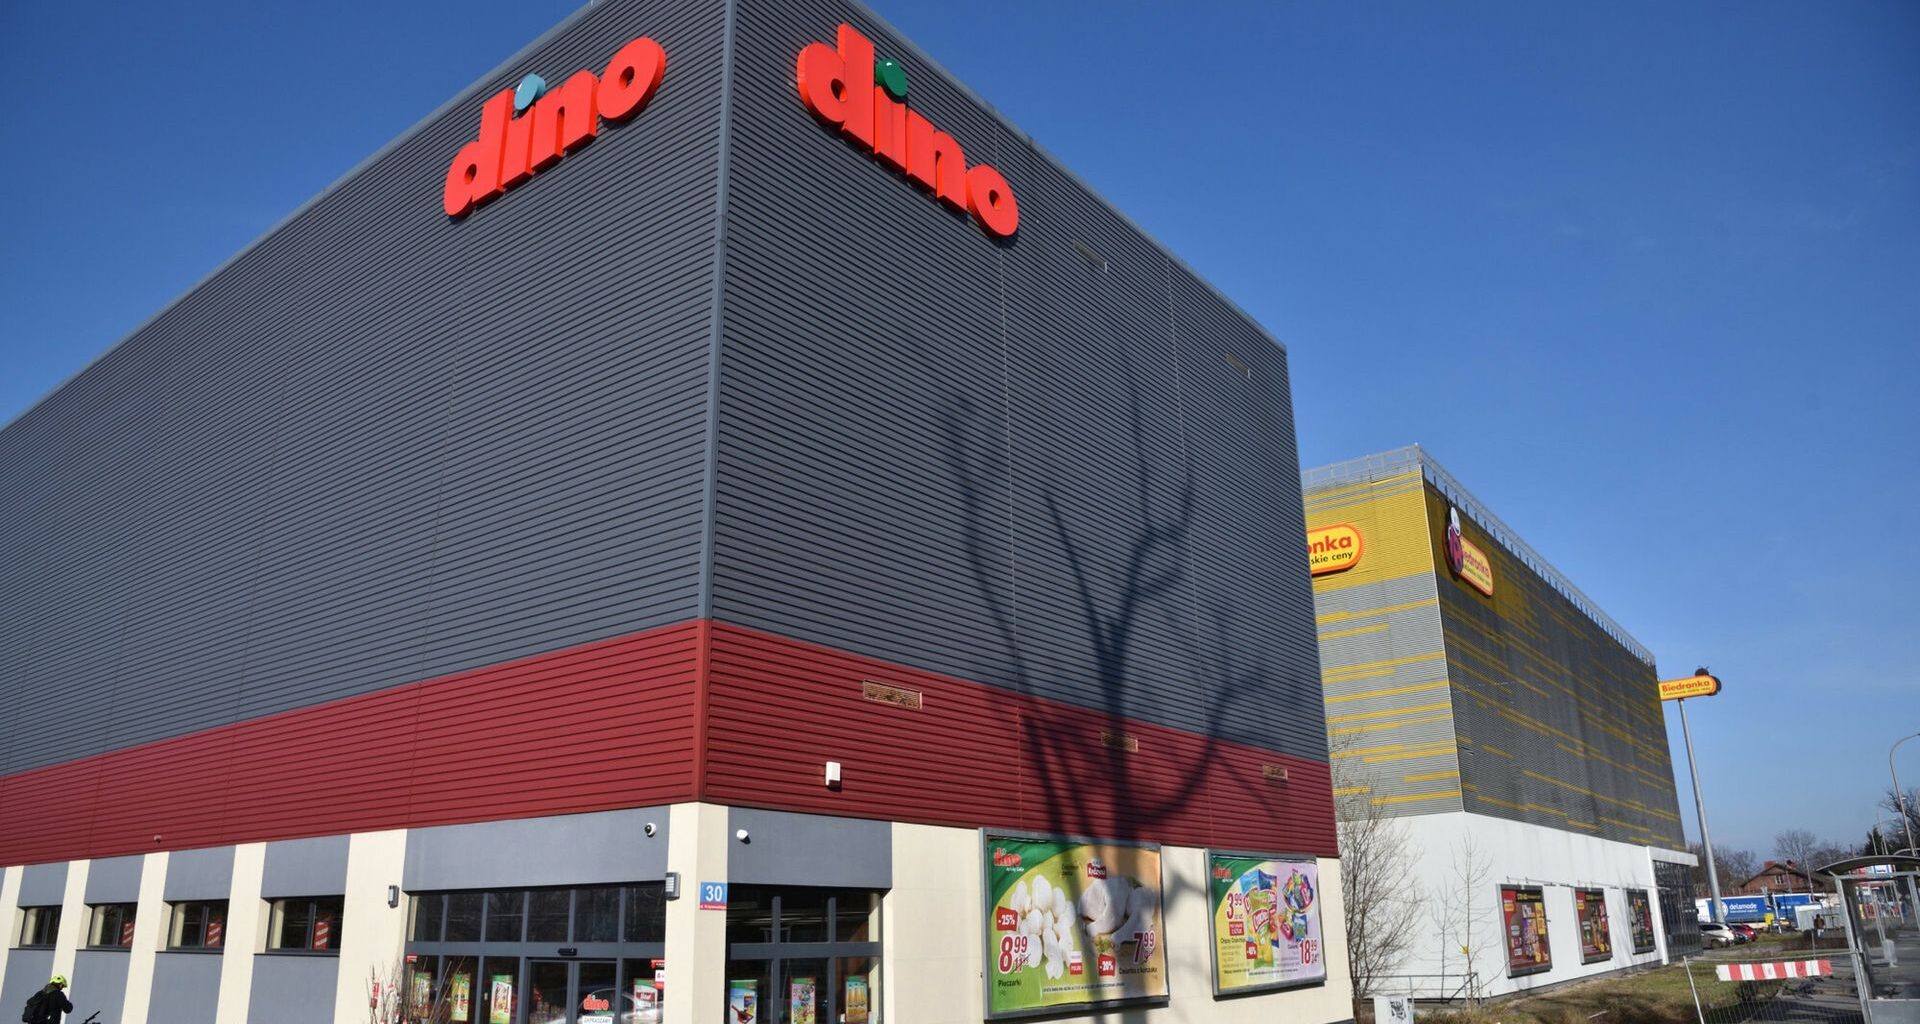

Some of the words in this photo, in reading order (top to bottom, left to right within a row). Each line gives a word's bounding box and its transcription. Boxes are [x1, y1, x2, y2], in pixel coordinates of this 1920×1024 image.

[444, 36, 666, 217] dino
[797, 23, 1019, 236] dino
[1331, 551, 1353, 560] ceny
[1463, 549, 1490, 577] edronka
[1662, 681, 1710, 692] Biedronka
[994, 847, 1022, 866] dino
[705, 885, 723, 901] 30
[998, 914, 1016, 926] -25%
[583, 994, 609, 1011] dino
